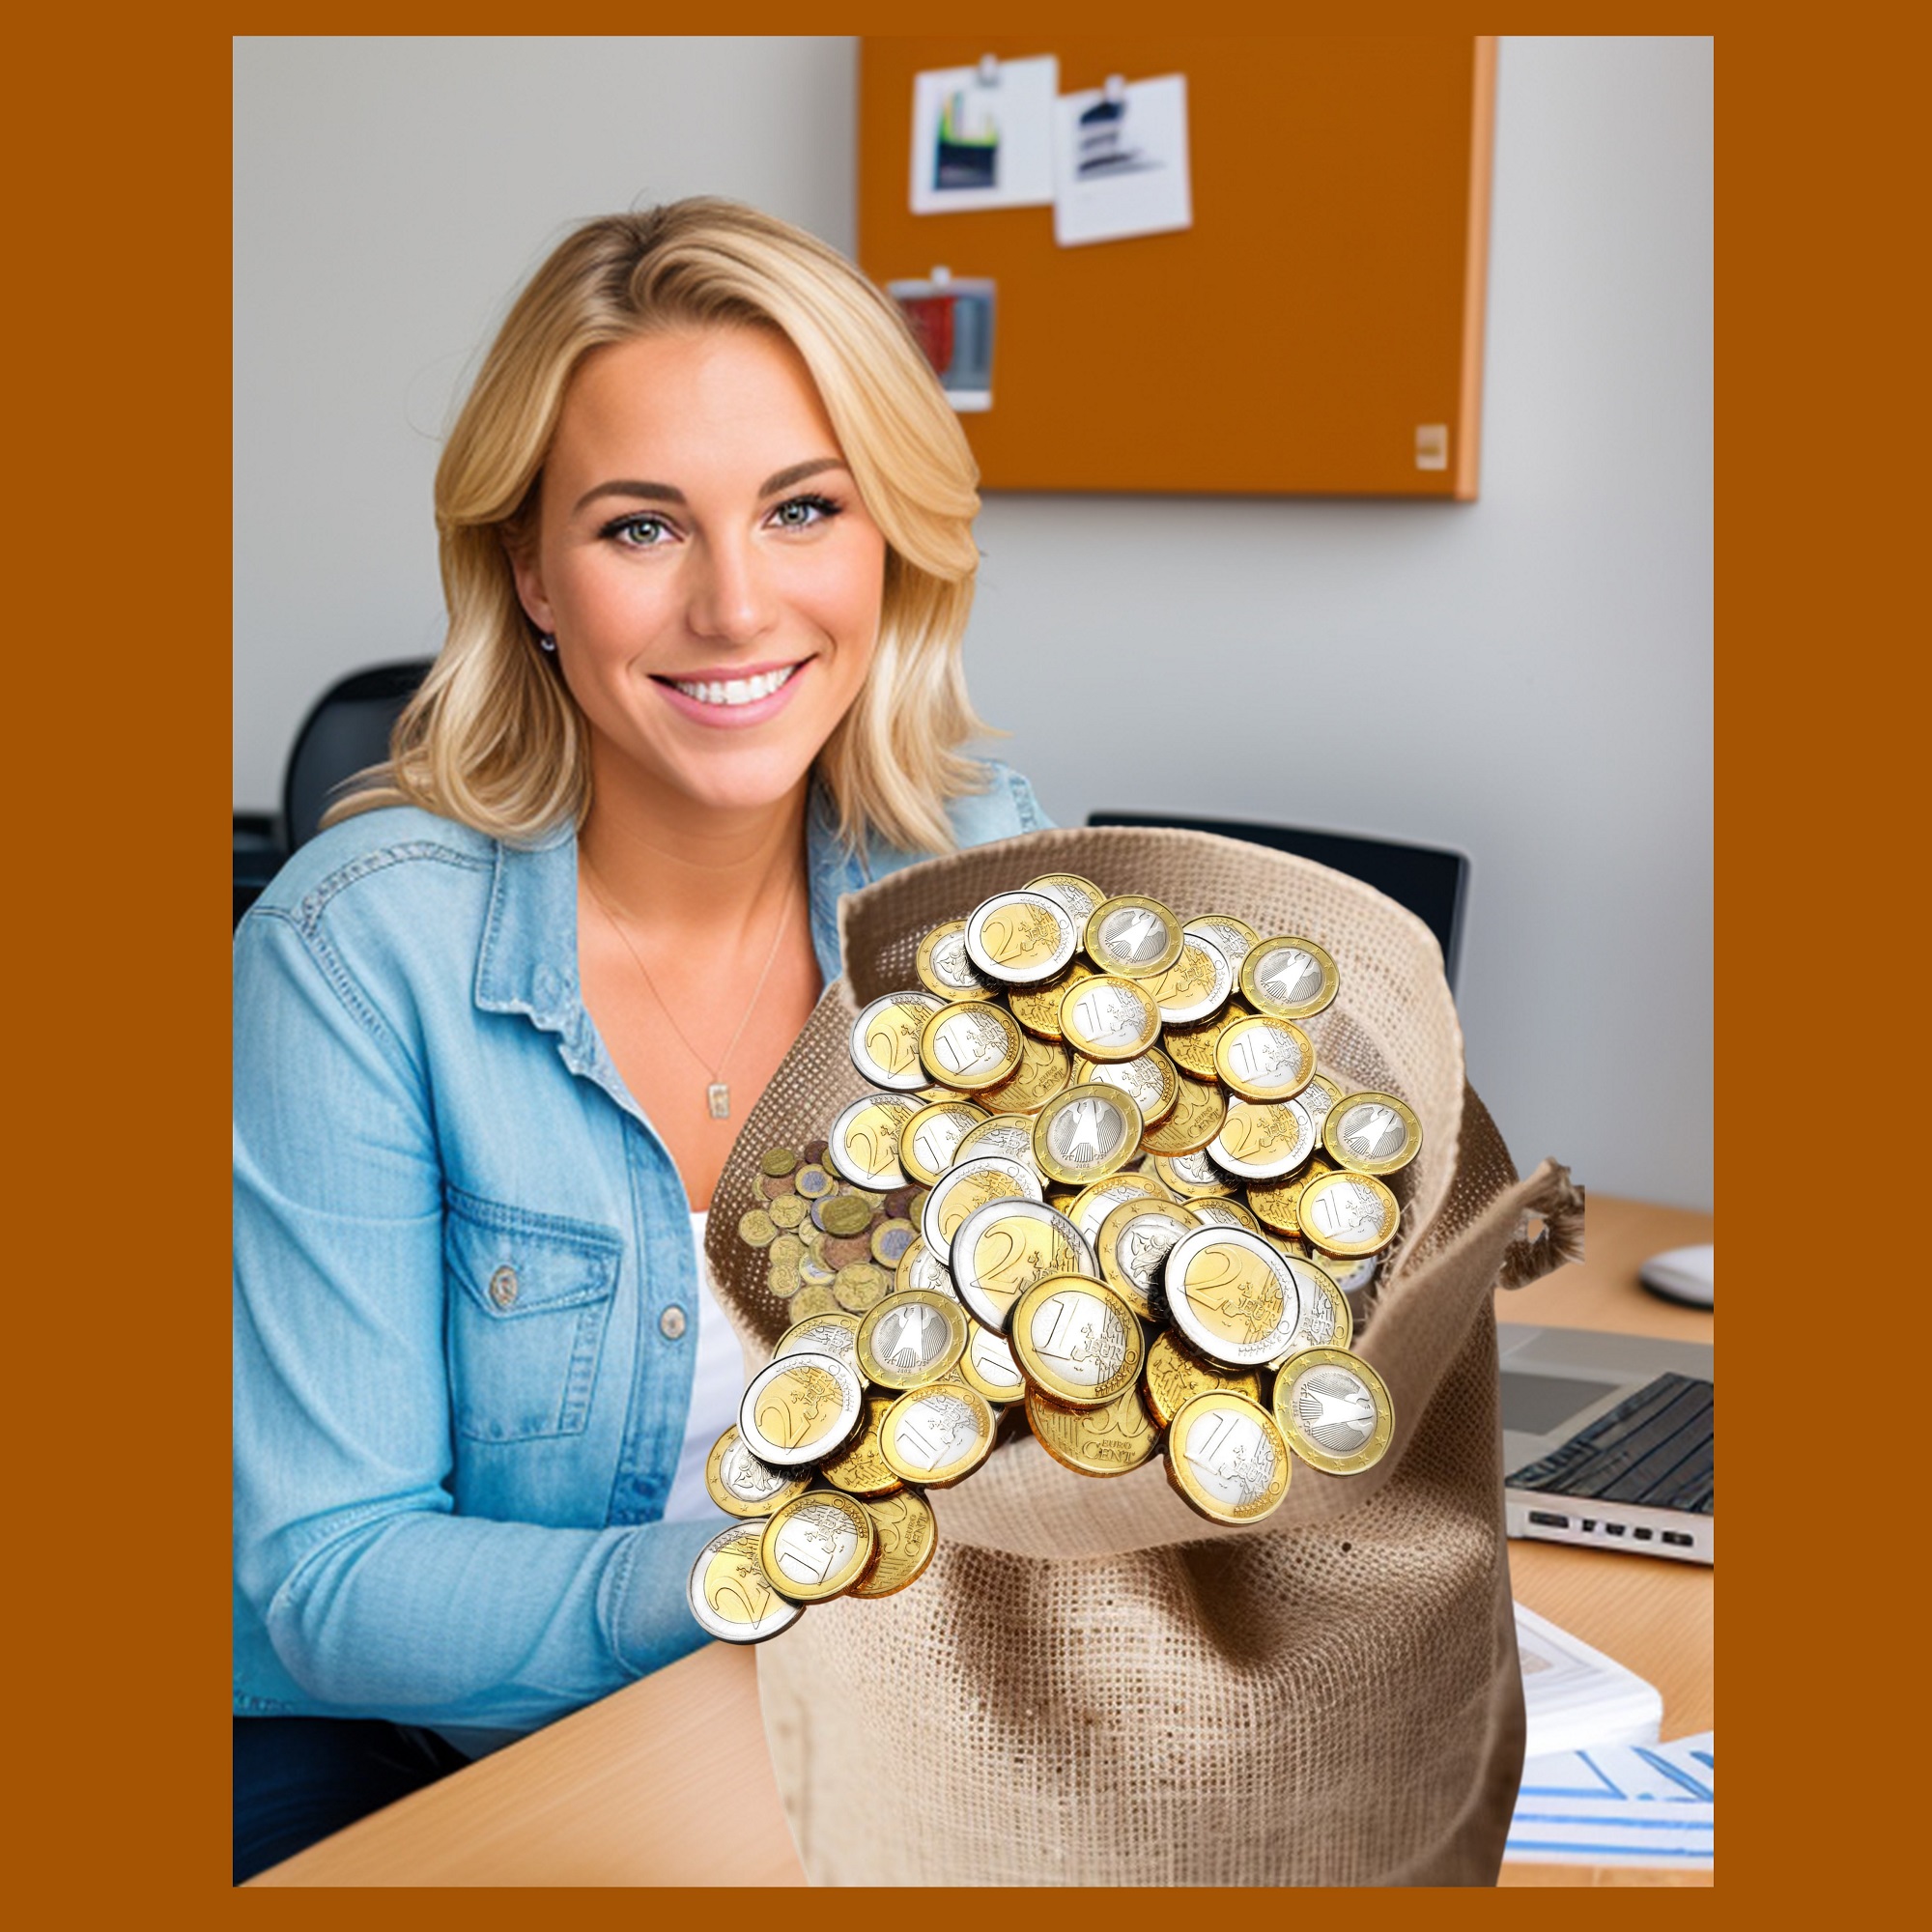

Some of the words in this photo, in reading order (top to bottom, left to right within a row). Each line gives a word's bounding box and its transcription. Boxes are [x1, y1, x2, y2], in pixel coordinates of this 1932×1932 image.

[982, 917, 1022, 966] 2
[1076, 992, 1115, 1043] 1
[867, 1022, 916, 1080] 2
[935, 1024, 980, 1076] 1
[1232, 1033, 1270, 1084] 1
[1032, 1069, 1066, 1098] CENT
[1187, 1109, 1221, 1138] CENT
[1224, 1111, 1262, 1162] 2
[846, 1123, 896, 1180] 2
[1315, 1189, 1353, 1239] 1
[969, 1222, 1027, 1295] 2
[1177, 1244, 1242, 1312] 2
[1031, 1297, 1080, 1362] 1
[755, 1396, 811, 1456] 2
[896, 1419, 952, 1473] 1
[1100, 1438, 1133, 1450] EURO
[1182, 1411, 1239, 1476] 1
[1081, 1440, 1137, 1464] CENT
[904, 1512, 928, 1557] CENT
[778, 1538, 835, 1587] 1
[708, 1575, 772, 1631] 2
